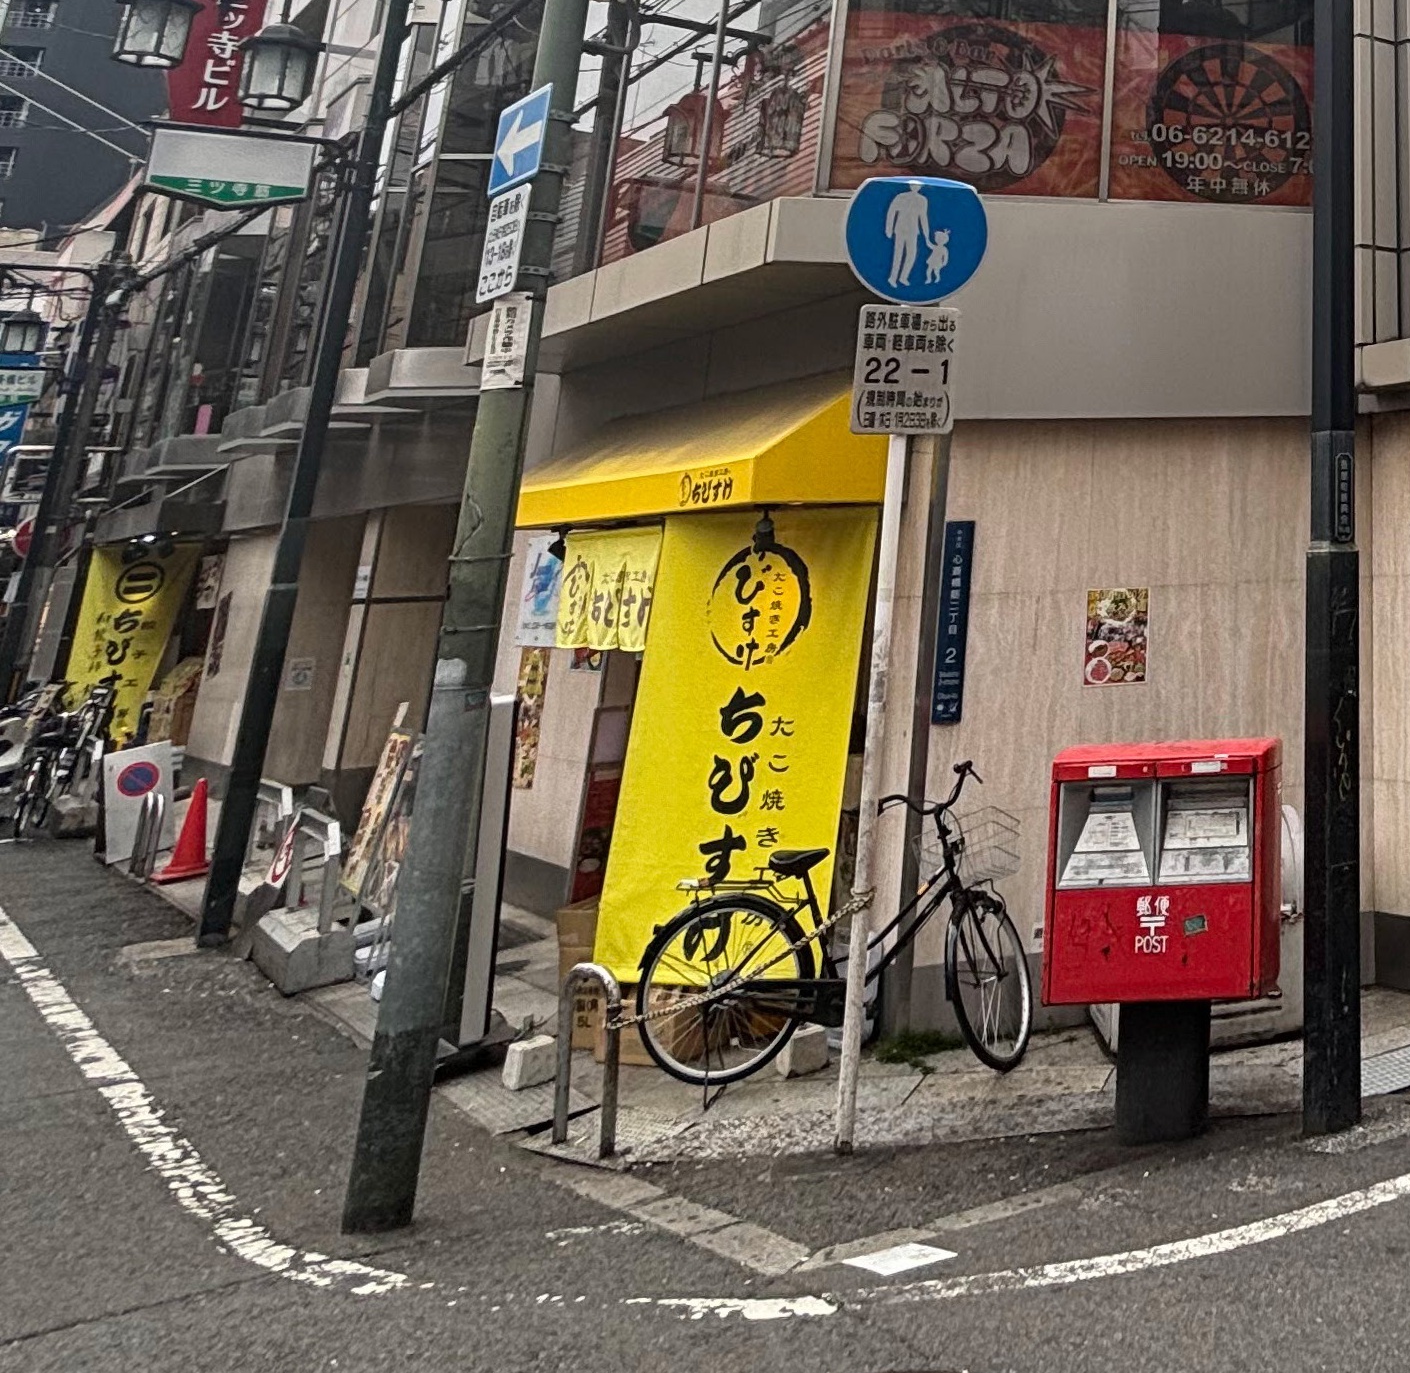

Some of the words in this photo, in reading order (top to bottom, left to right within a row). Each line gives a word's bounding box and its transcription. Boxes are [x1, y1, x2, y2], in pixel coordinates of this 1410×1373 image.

[1151, 123, 1311, 150] 06-6214-612
[1118, 154, 1157, 167] OPEN
[1289, 156, 1313, 174] 7:
[1186, 176, 1271, 196] 年中無休
[864, 310, 957, 332] 路外駐車場から出る
[944, 647, 957, 664] 2
[1136, 895, 1170, 917] 郵便
[1134, 935, 1169, 954] POST
